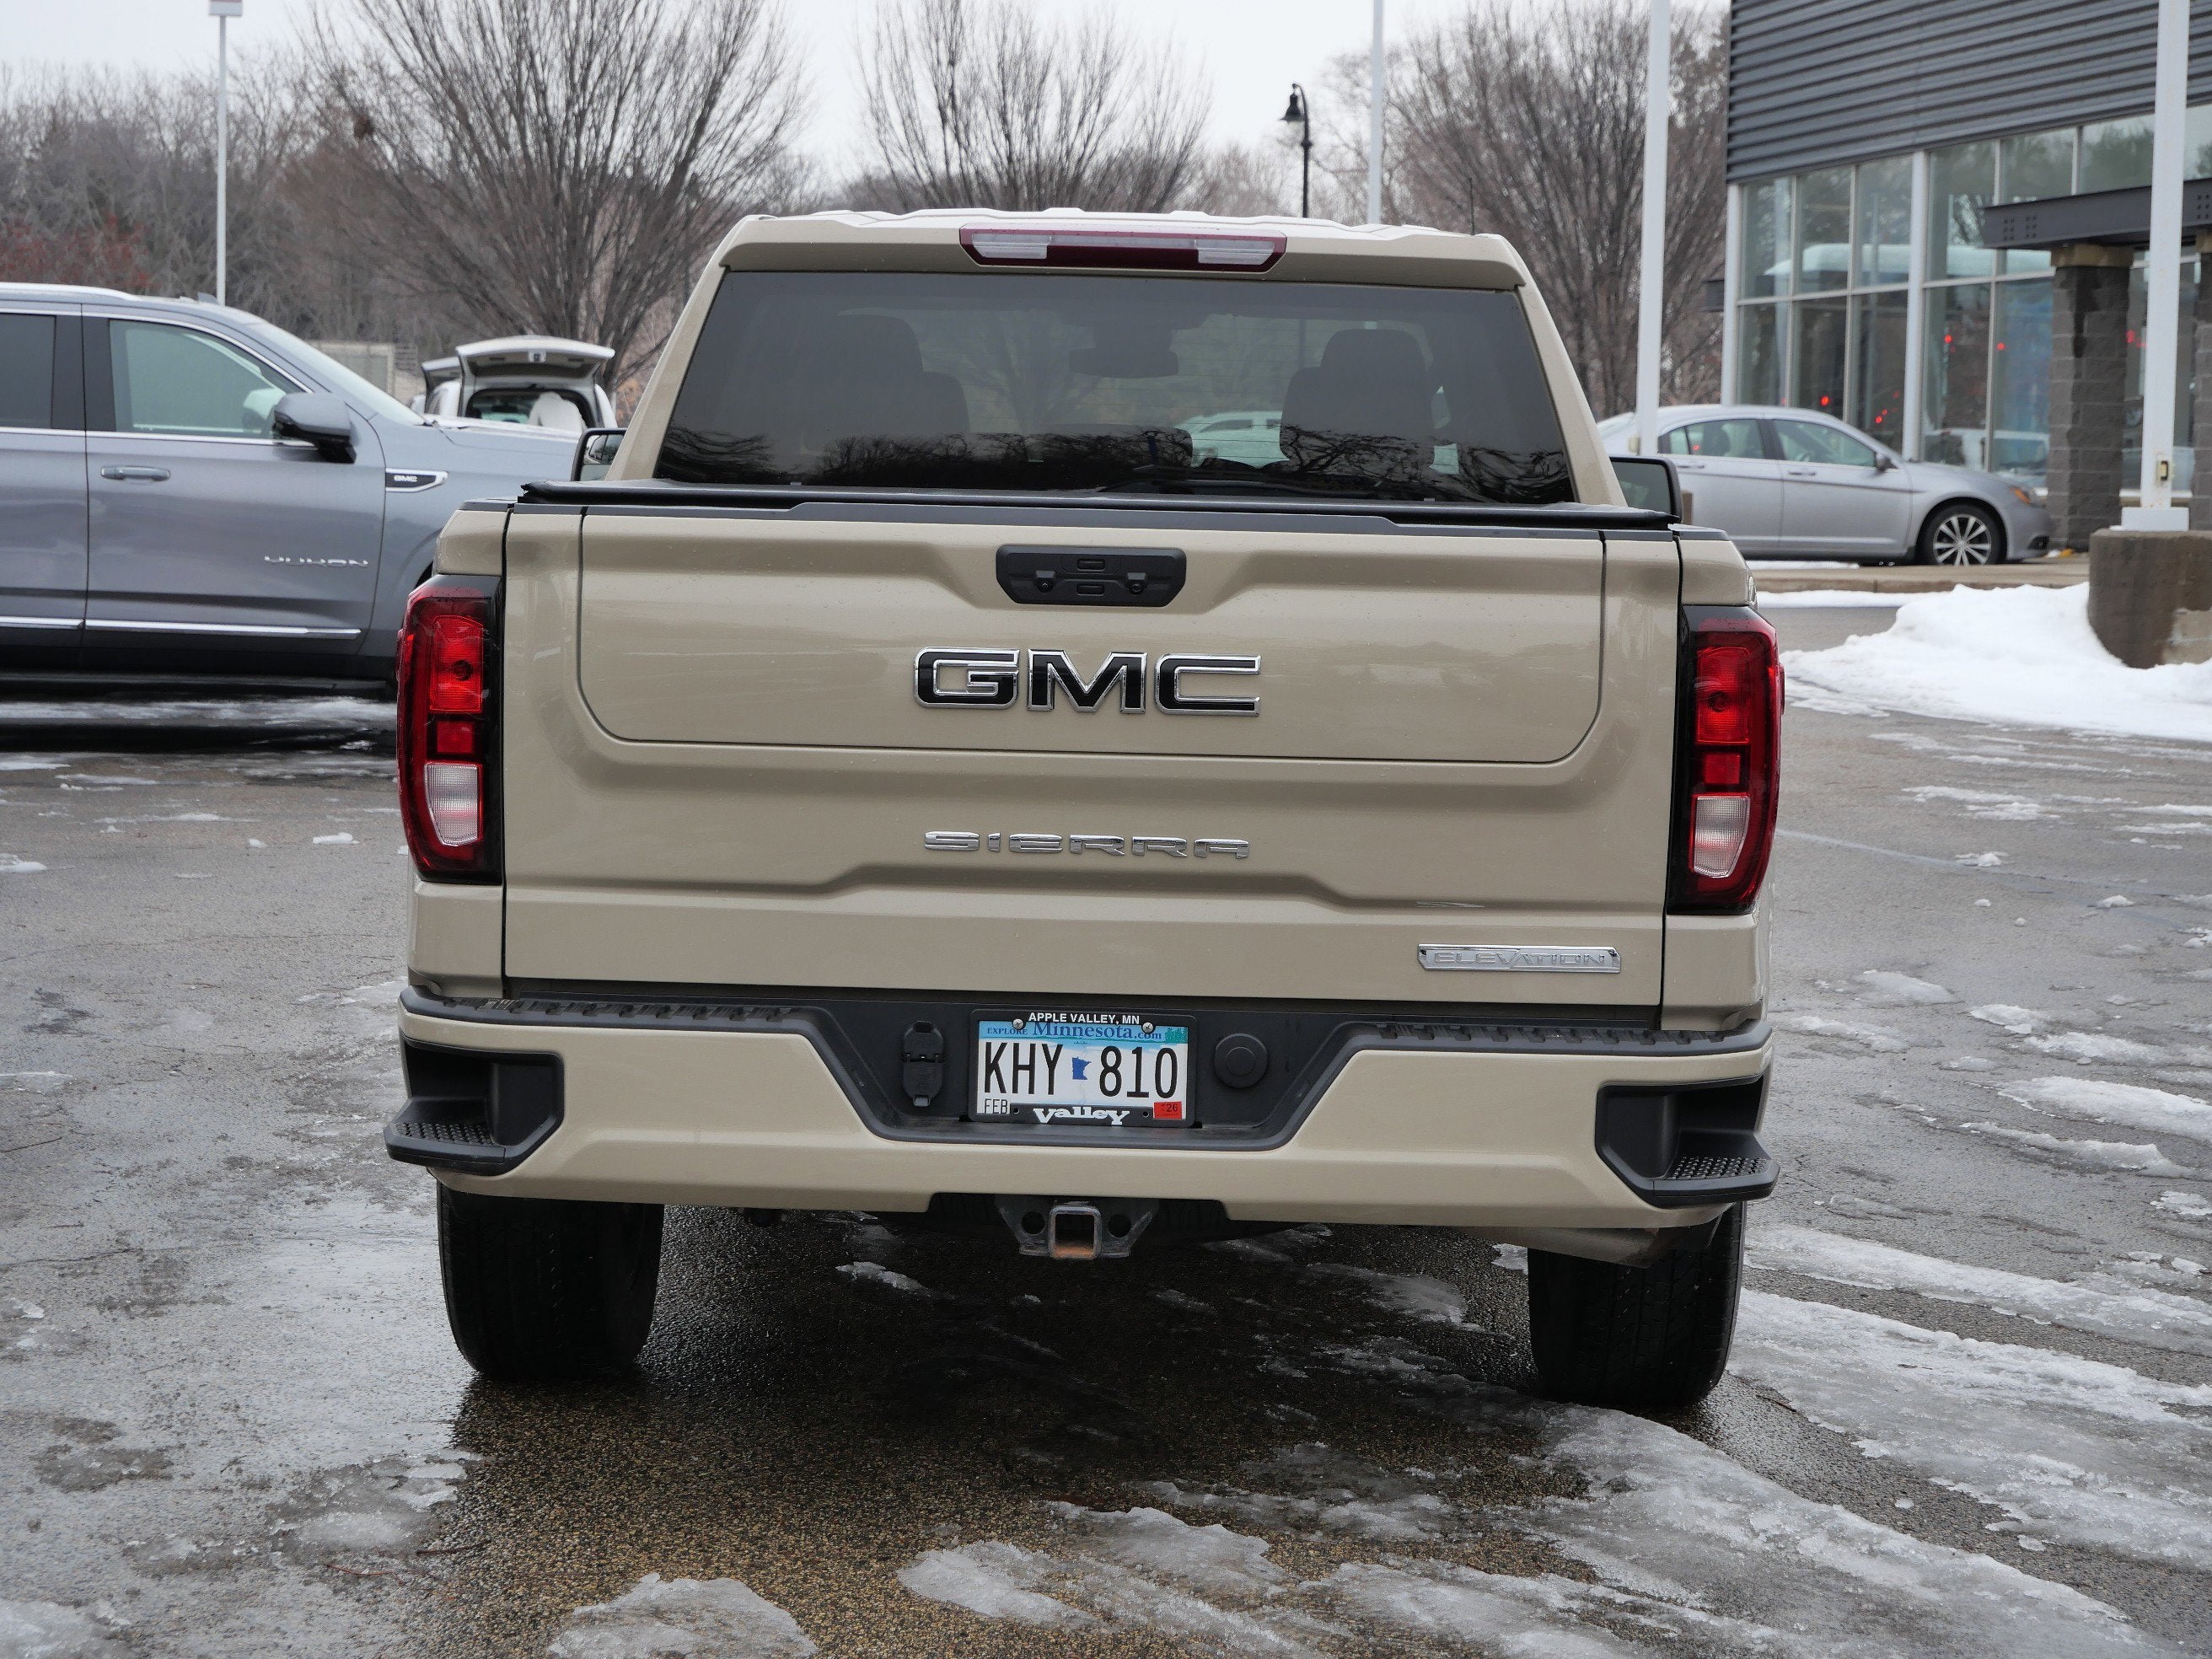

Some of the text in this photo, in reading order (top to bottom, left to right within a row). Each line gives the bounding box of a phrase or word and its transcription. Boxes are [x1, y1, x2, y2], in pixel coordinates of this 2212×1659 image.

[915, 647, 1261, 717] GMC
[924, 831, 1249, 860] SIERRA
[1434, 952, 1606, 965] ELEVATION
[1028, 1012, 1140, 1025] APPLE VALLEY, MN
[986, 1027, 1028, 1036] EXPLORE
[984, 1041, 1178, 1099] KHY 810
[984, 1098, 1008, 1114] FEB
[1166, 1103, 1178, 1113] 26
